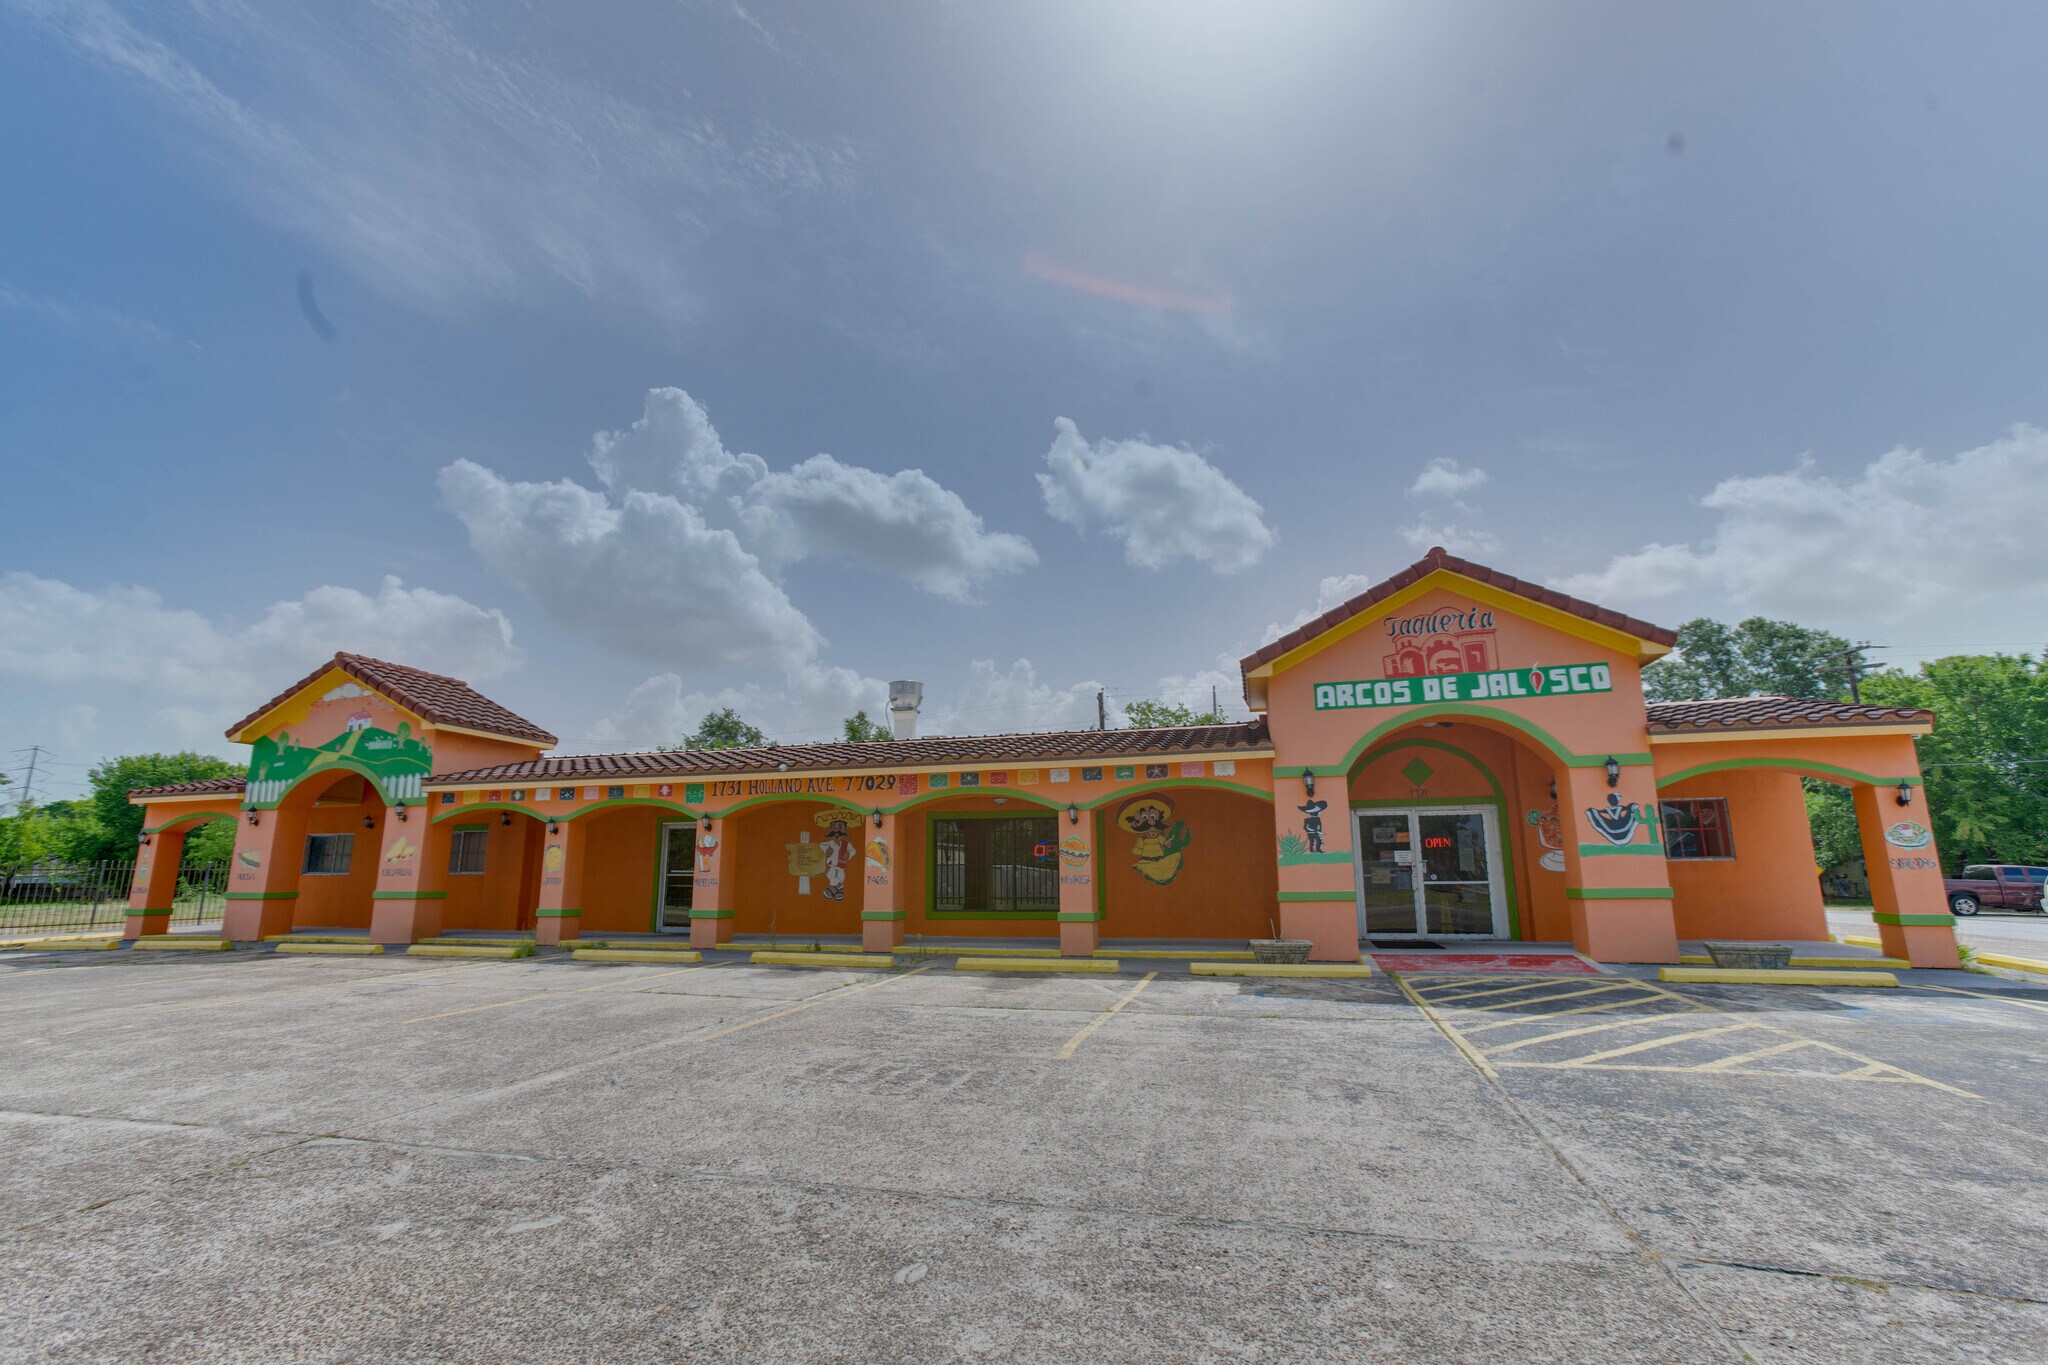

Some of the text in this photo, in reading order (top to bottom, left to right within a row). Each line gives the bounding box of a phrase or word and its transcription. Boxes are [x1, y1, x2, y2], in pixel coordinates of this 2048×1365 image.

[1382, 606, 1494, 638] Taqueria
[1315, 680, 1412, 708] ARCOS
[1422, 676, 1460, 701] DE
[712, 774, 897, 797] 1731 HOLLAND AVE. 77029
[1425, 837, 1452, 849] OPEN
